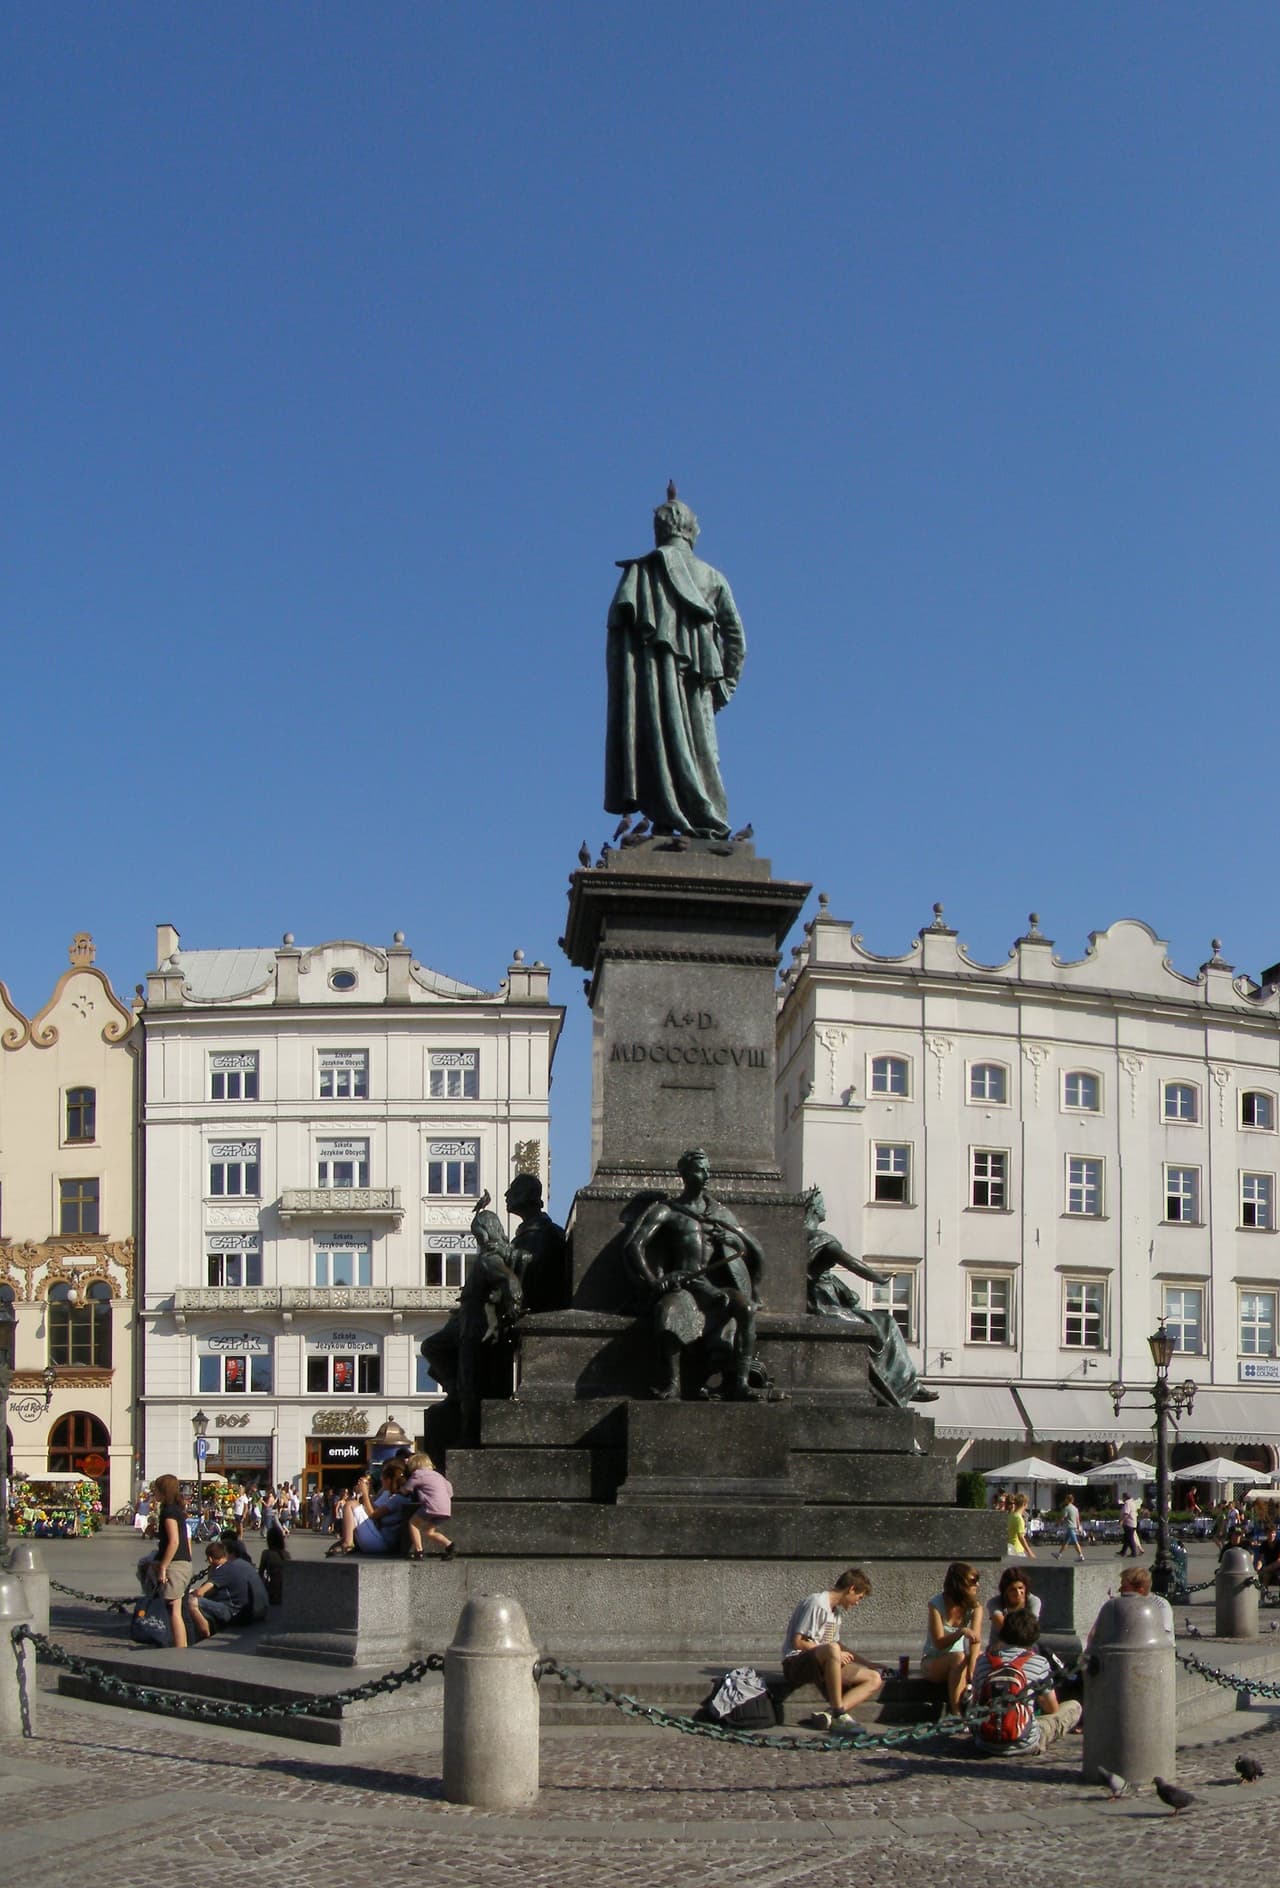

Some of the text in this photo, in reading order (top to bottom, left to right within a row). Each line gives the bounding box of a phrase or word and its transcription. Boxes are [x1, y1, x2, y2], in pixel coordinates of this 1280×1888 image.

[609, 1043, 768, 1068] MDCCCXCVIII
[332, 1332, 357, 1340] Szkoła
[315, 1342, 345, 1351] Języków
[10, 1402, 29, 1411] Hard
[200, 1441, 206, 1457] P
[227, 1445, 268, 1455] BIELIZNA
[328, 1446, 359, 1457] empik
